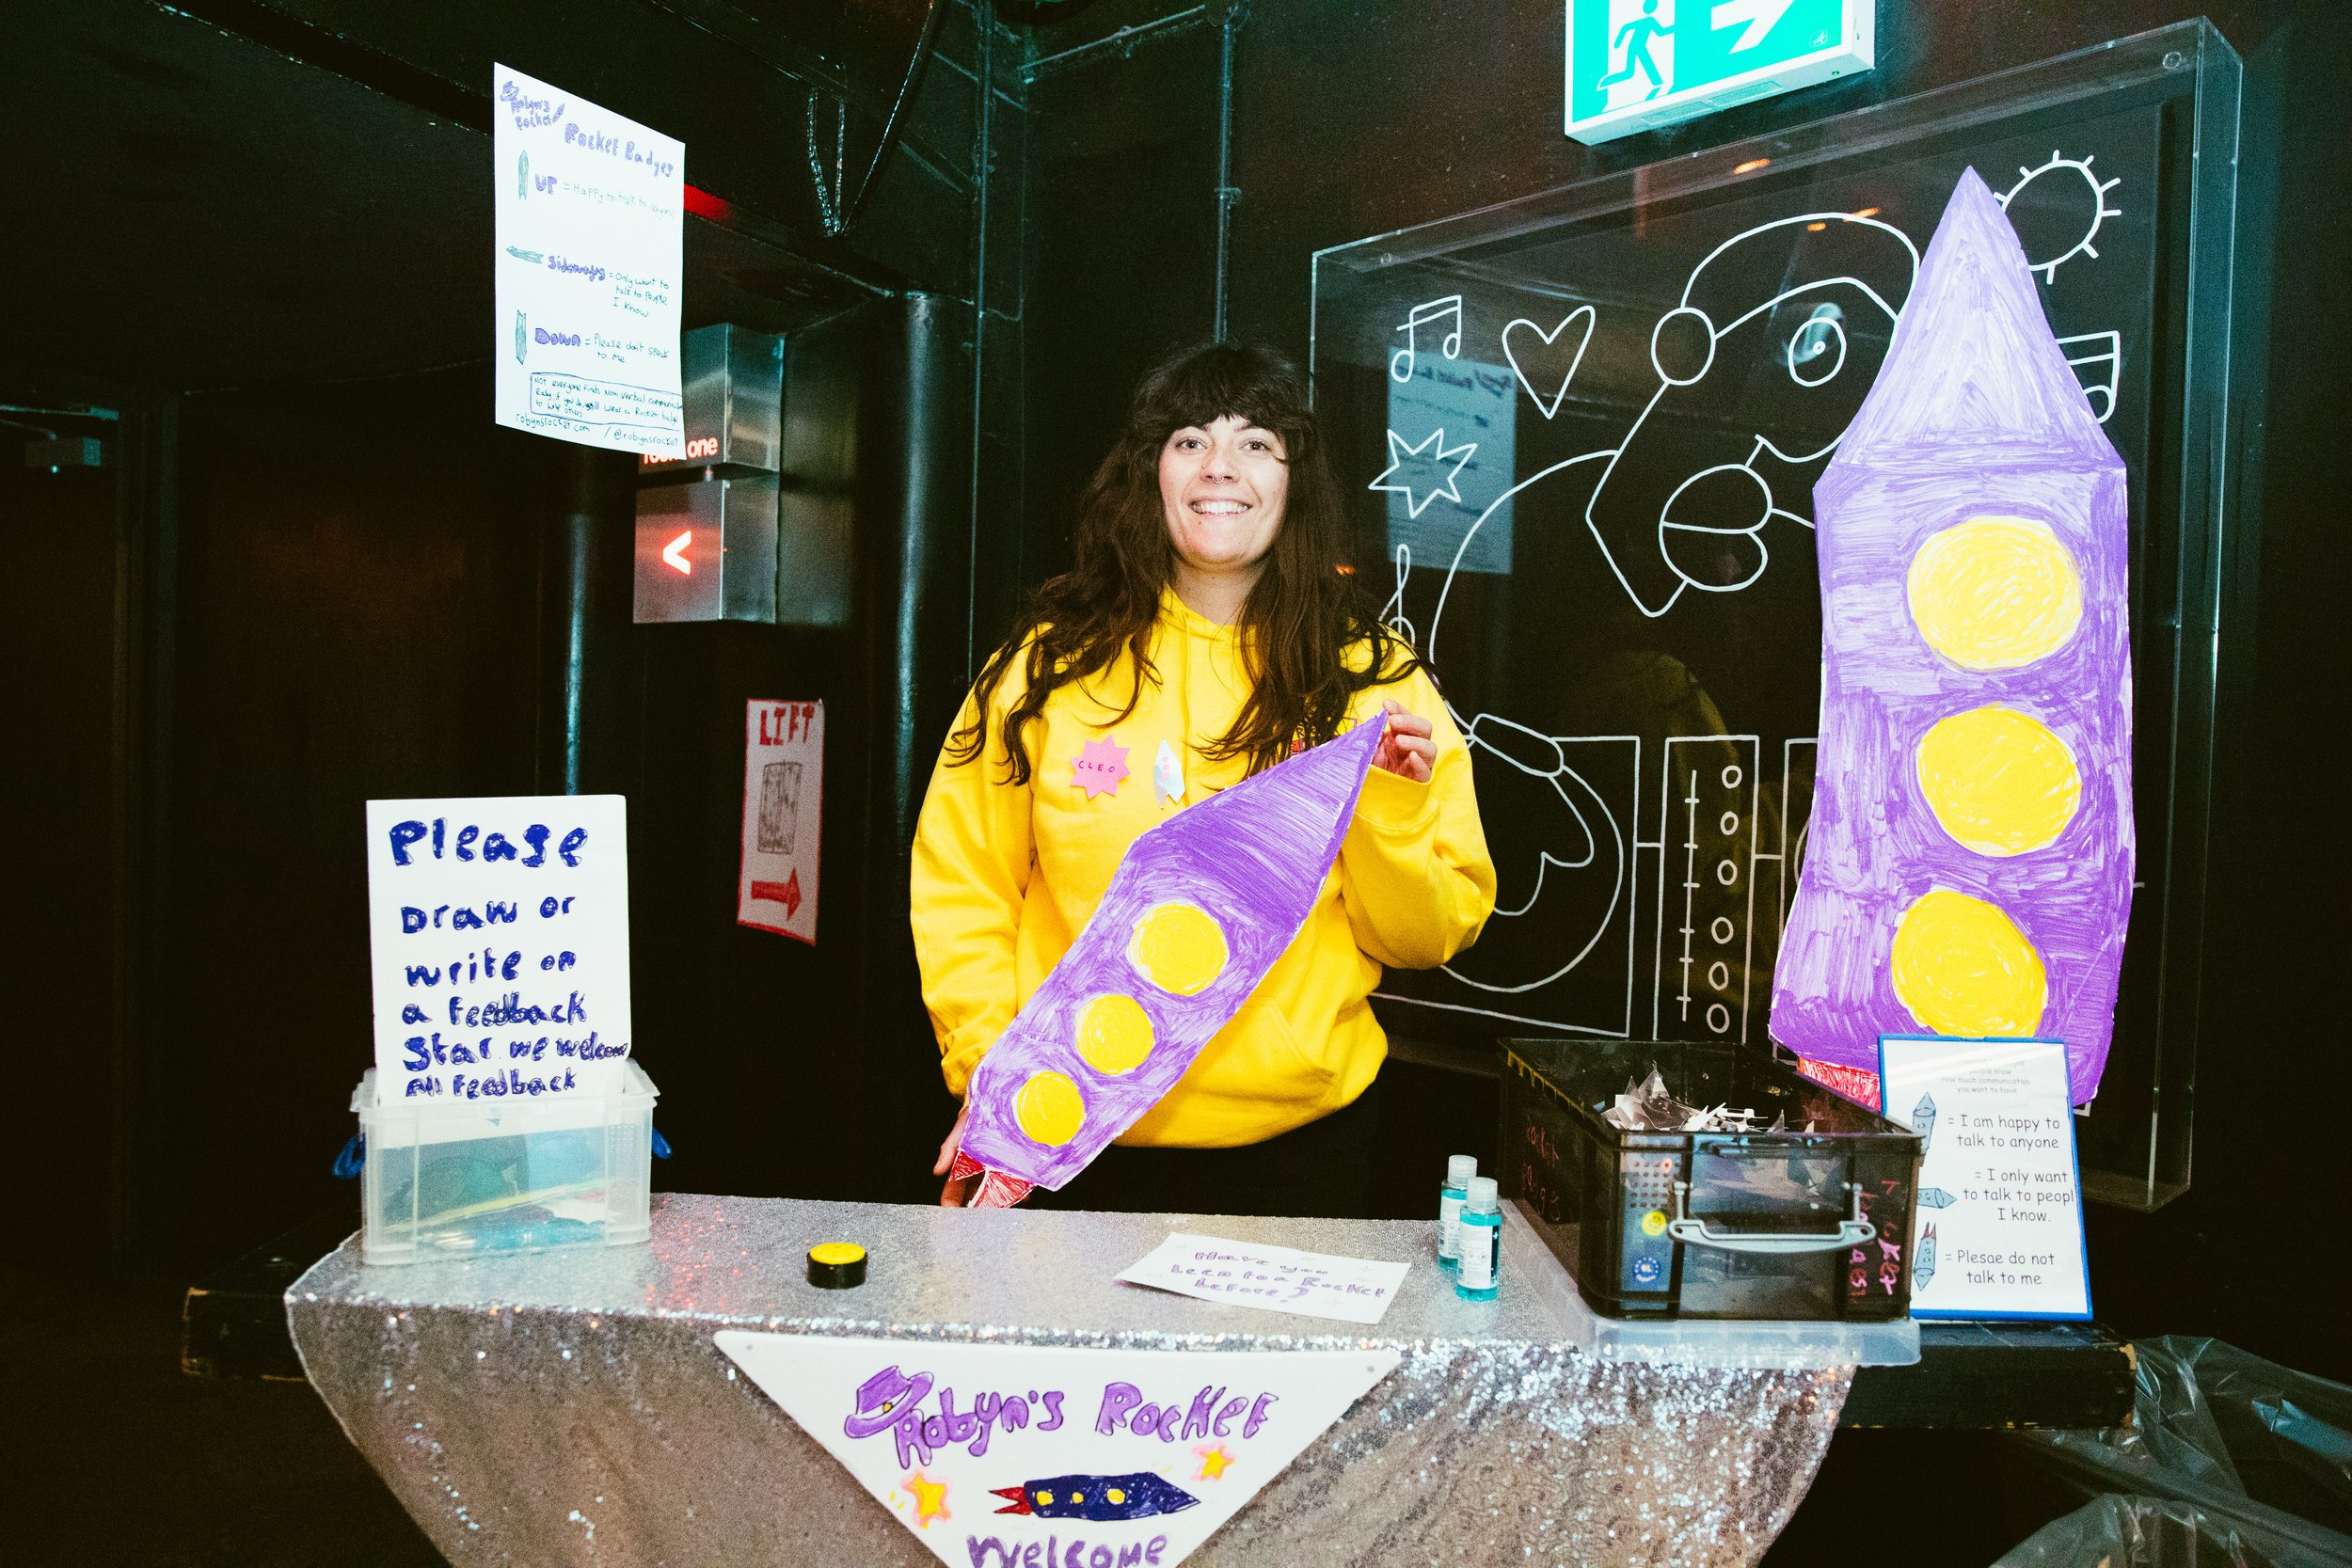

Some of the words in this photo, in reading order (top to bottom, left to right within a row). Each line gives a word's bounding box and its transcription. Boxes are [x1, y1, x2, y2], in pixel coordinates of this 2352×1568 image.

[564, 123, 619, 156] Rocket
[625, 141, 674, 177] Badges
[535, 174, 558, 195] UP
[548, 255, 606, 282] Sideways
[615, 272, 634, 288] Only
[635, 277, 657, 287] want
[660, 278, 670, 290] to
[616, 284, 631, 296] talk
[634, 290, 643, 299] to
[612, 296, 621, 308] I
[534, 327, 580, 347] Down
[594, 332, 622, 350] Please
[596, 350, 607, 359] to
[612, 353, 626, 364] me
[552, 380, 580, 394] everyone
[516, 412, 591, 433] robynsrocketcom
[687, 436, 719, 459] one
[759, 705, 816, 746] LIFT
[1078, 760, 1116, 773] CLEO
[389, 816, 588, 868] Please
[400, 900, 517, 934] Draw
[539, 895, 577, 919] or
[404, 947, 521, 988] write
[540, 950, 577, 972] on
[402, 1003, 434, 1025] a
[403, 1031, 494, 1072] Star
[509, 1037, 549, 1062] we
[1957, 1085, 1970, 1094] you
[1960, 1114, 1968, 1128] I
[1972, 1117, 1994, 1128] am
[1998, 1115, 2041, 1132] happy
[2045, 1117, 2060, 1130] to
[1957, 1133, 1985, 1148] talk
[1989, 1134, 2005, 1148] to
[2010, 1137, 2059, 1151] anyone
[1987, 1168, 1996, 1182] I
[2000, 1168, 2029, 1185] only
[2034, 1171, 2068, 1183] want
[1963, 1187, 1978, 1201] to
[1983, 1188, 2011, 1202] talk
[2016, 1189, 2032, 1202] to
[2036, 1189, 2074, 1207] peopl
[1997, 1208, 2007, 1222] I
[2011, 1208, 2052, 1223] know.
[1957, 1249, 2004, 1265] Plesae
[2009, 1251, 2026, 1265] do
[2031, 1252, 2055, 1266] not
[1171, 1264, 1232, 1277] been
[1279, 1265, 1328, 1275] you
[1966, 1270, 1994, 1285] talk
[2000, 1271, 2016, 1285] to
[2020, 1274, 2043, 1286] me
[894, 1386, 1065, 1469] Robyn's
